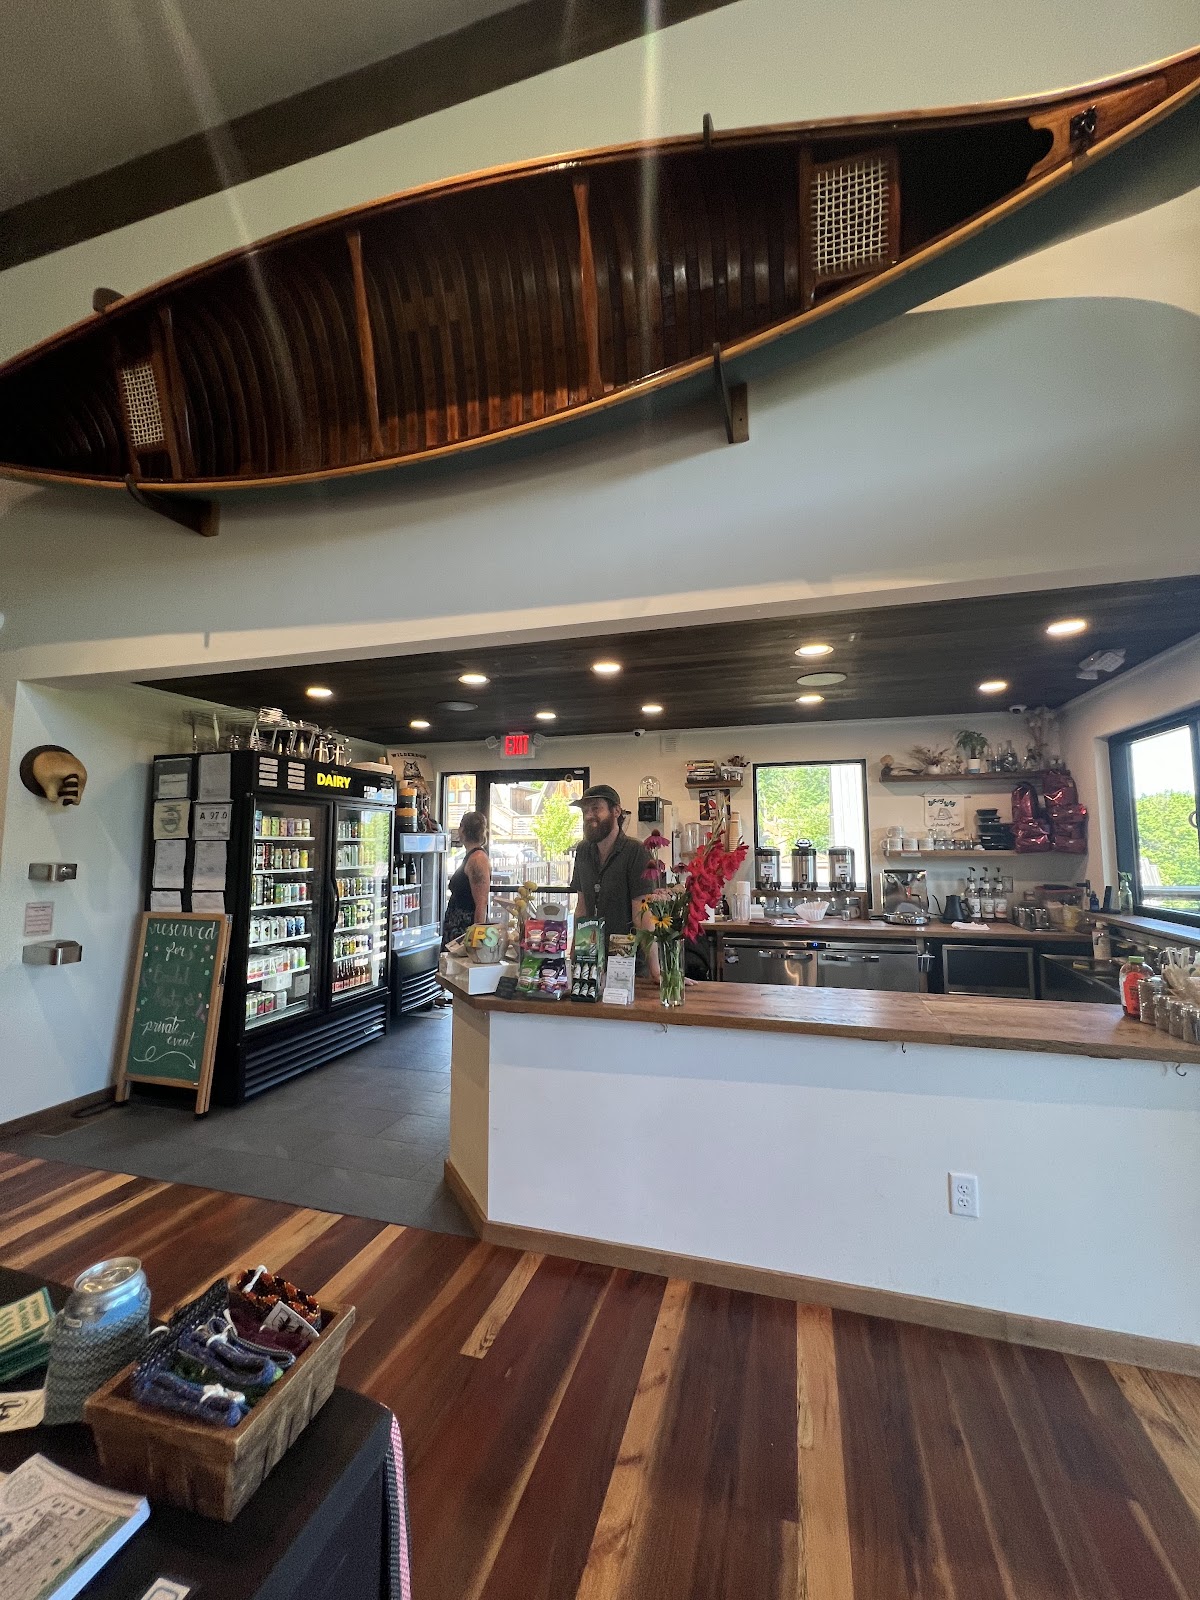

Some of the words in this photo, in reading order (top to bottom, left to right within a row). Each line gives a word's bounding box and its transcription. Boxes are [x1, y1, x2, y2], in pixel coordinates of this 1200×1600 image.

[505, 735, 529, 755] EXIT
[317, 773, 351, 789] DAIRY
[200, 812, 206, 820] A
[149, 922, 218, 940] reserved
[165, 941, 186, 962] for
[140, 1016, 186, 1036] private
[166, 1032, 199, 1047] event
